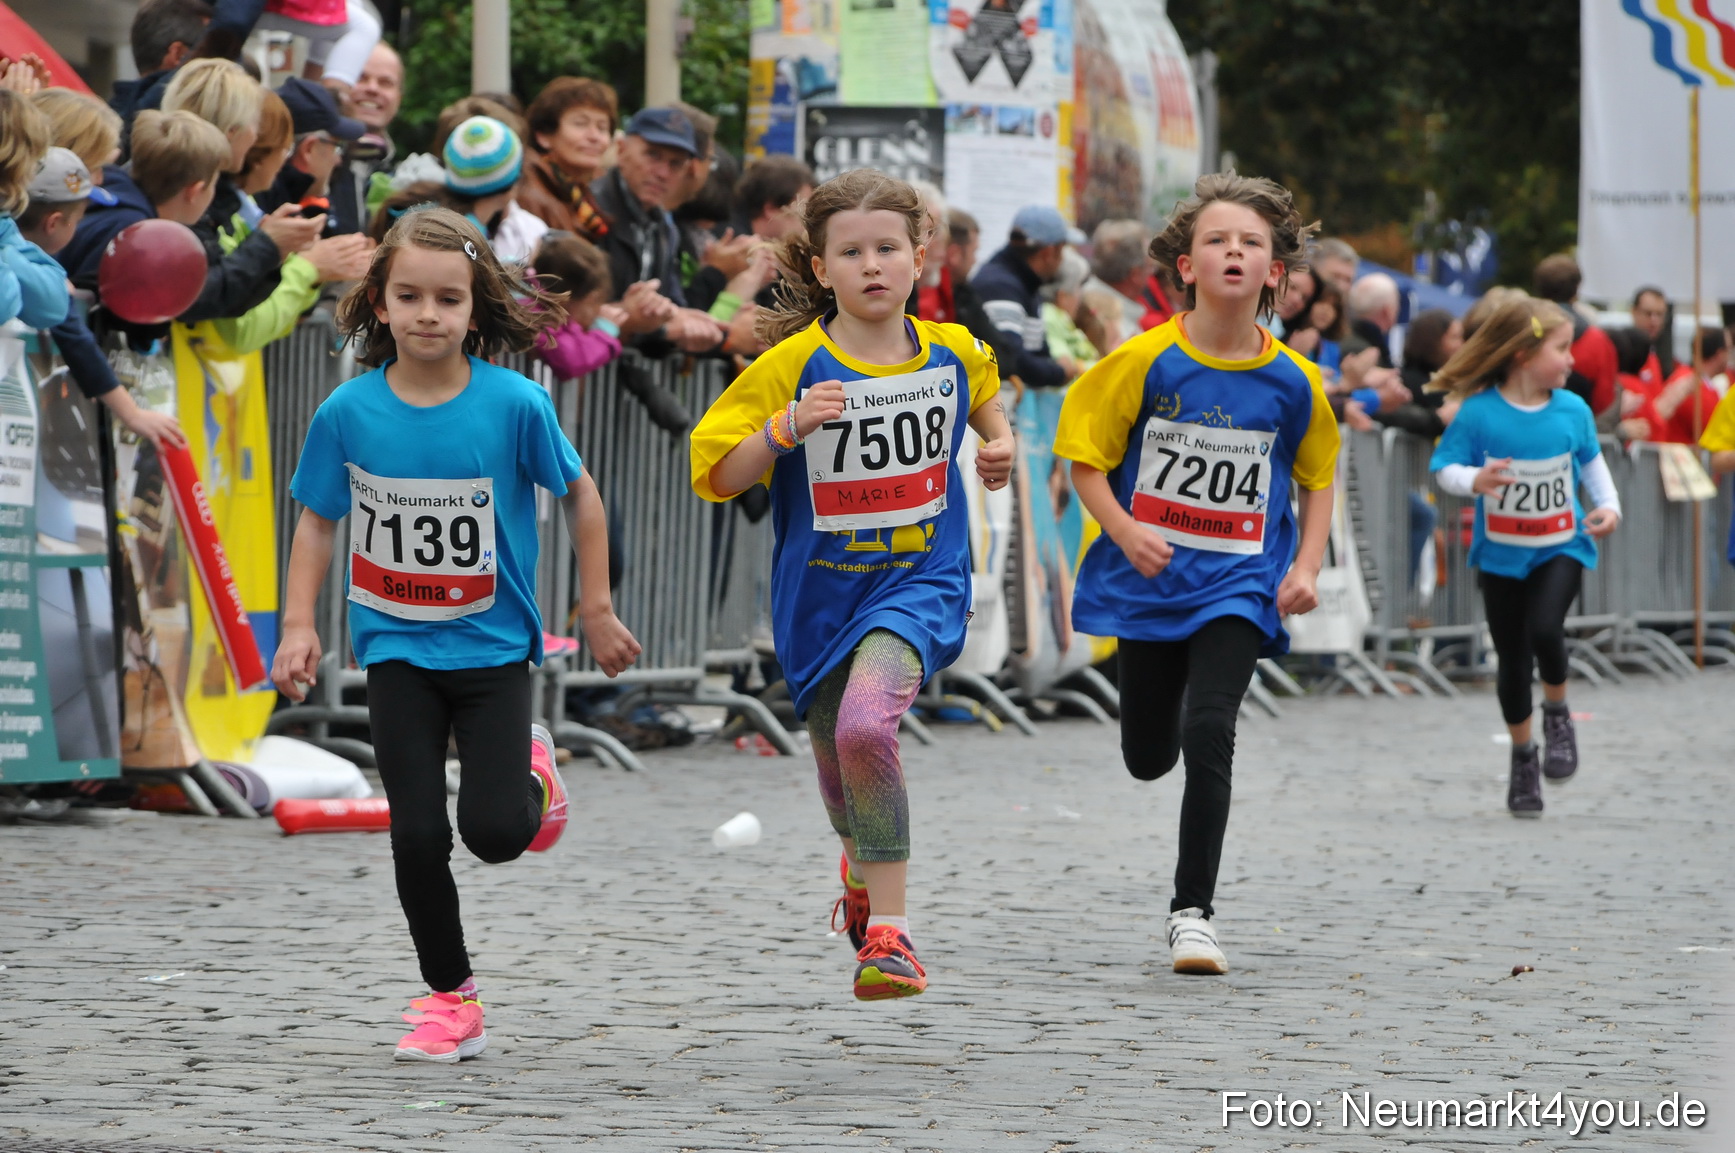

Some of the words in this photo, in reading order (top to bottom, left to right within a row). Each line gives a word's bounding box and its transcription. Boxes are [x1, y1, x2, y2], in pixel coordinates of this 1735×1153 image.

[813, 135, 931, 164] GLENN
[864, 386, 935, 408] Neumarkt
[822, 405, 946, 473] 7508
[1147, 430, 1190, 447] PARTL
[1194, 438, 1256, 455] Neumarkt
[1154, 447, 1261, 505] 7204
[351, 476, 383, 503] PARTL
[387, 492, 465, 508] Neumarkt
[837, 484, 906, 507] MARIE
[1498, 477, 1566, 512] 7208
[359, 501, 480, 568] 7139
[1160, 506, 1233, 534] Johanna
[383, 575, 446, 601] Selma
